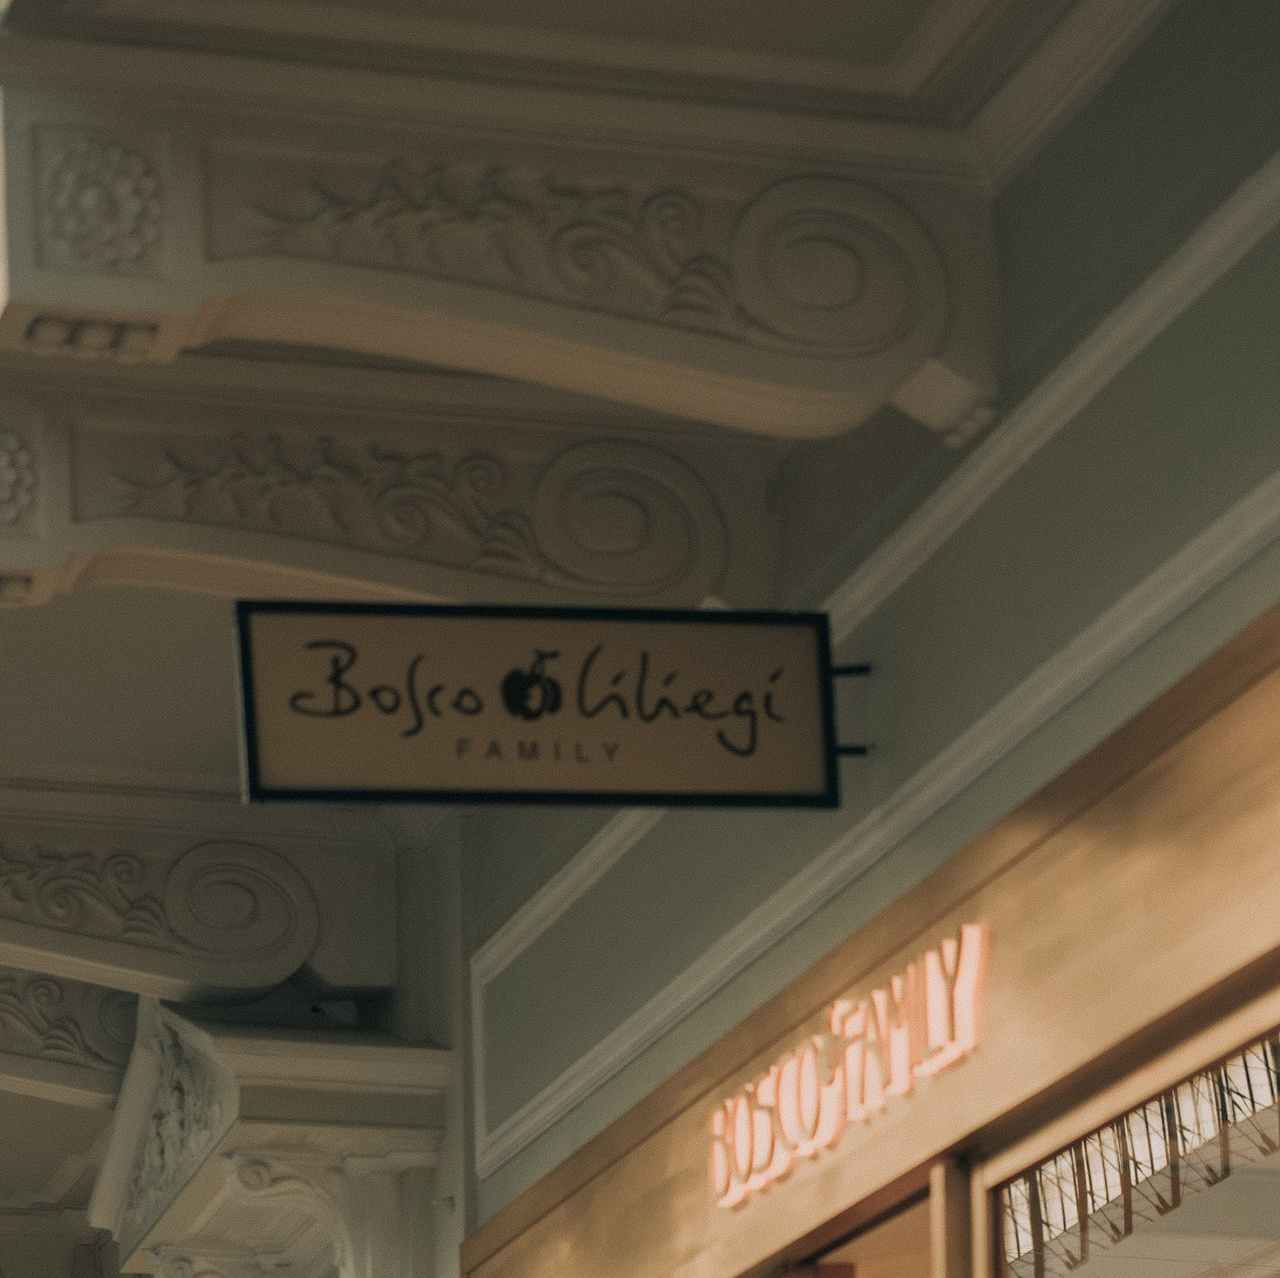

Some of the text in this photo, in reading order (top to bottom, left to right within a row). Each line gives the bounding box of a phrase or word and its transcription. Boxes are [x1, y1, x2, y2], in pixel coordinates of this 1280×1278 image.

[290, 638, 785, 757] Bosco Ciliegi
[456, 737, 620, 763] FAMILY
